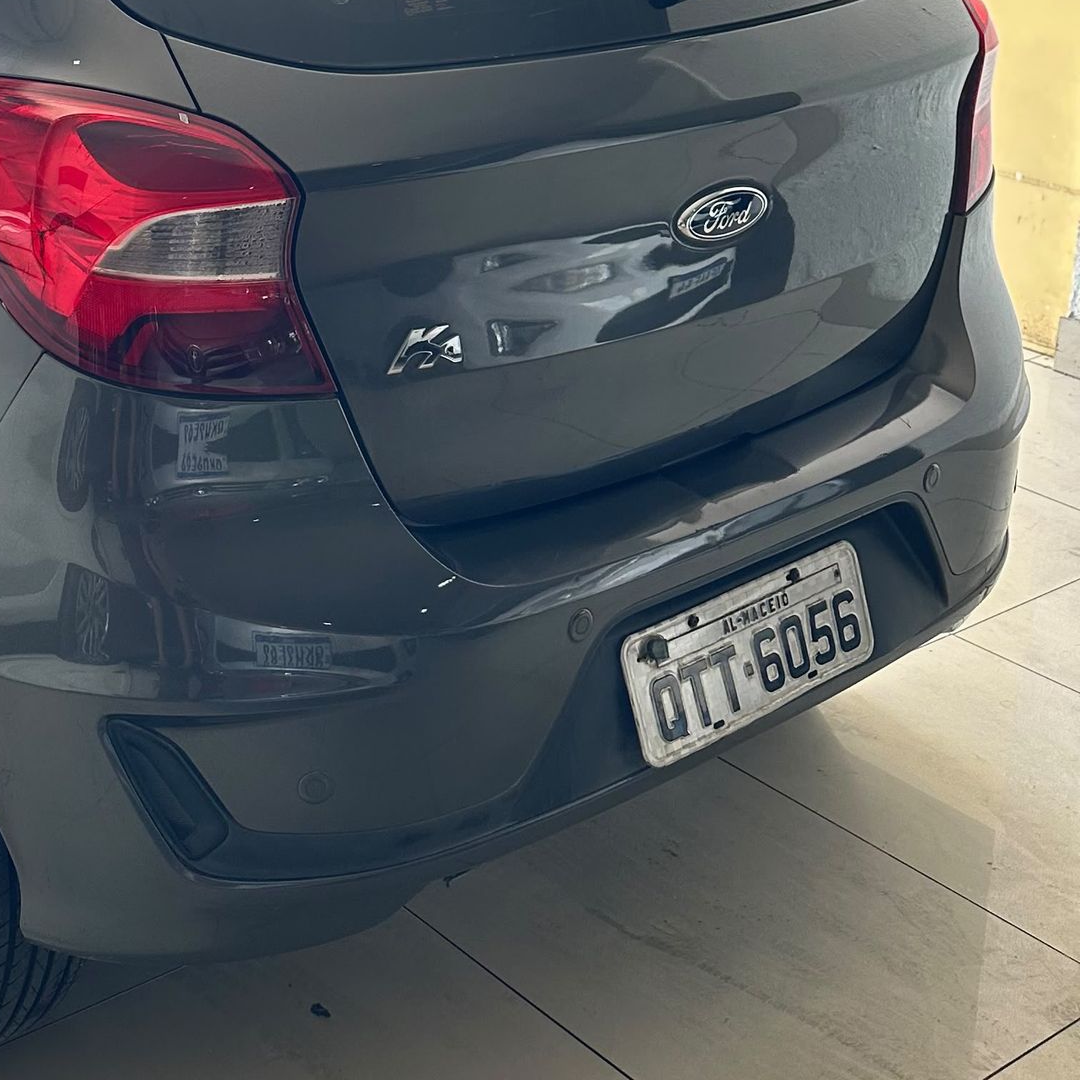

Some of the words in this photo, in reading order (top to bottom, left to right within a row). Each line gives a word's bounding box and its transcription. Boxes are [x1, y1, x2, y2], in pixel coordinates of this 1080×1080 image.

[703, 198, 752, 235] Ford
[386, 324, 462, 376] Ka
[722, 592, 790, 635] AL-MACEIO
